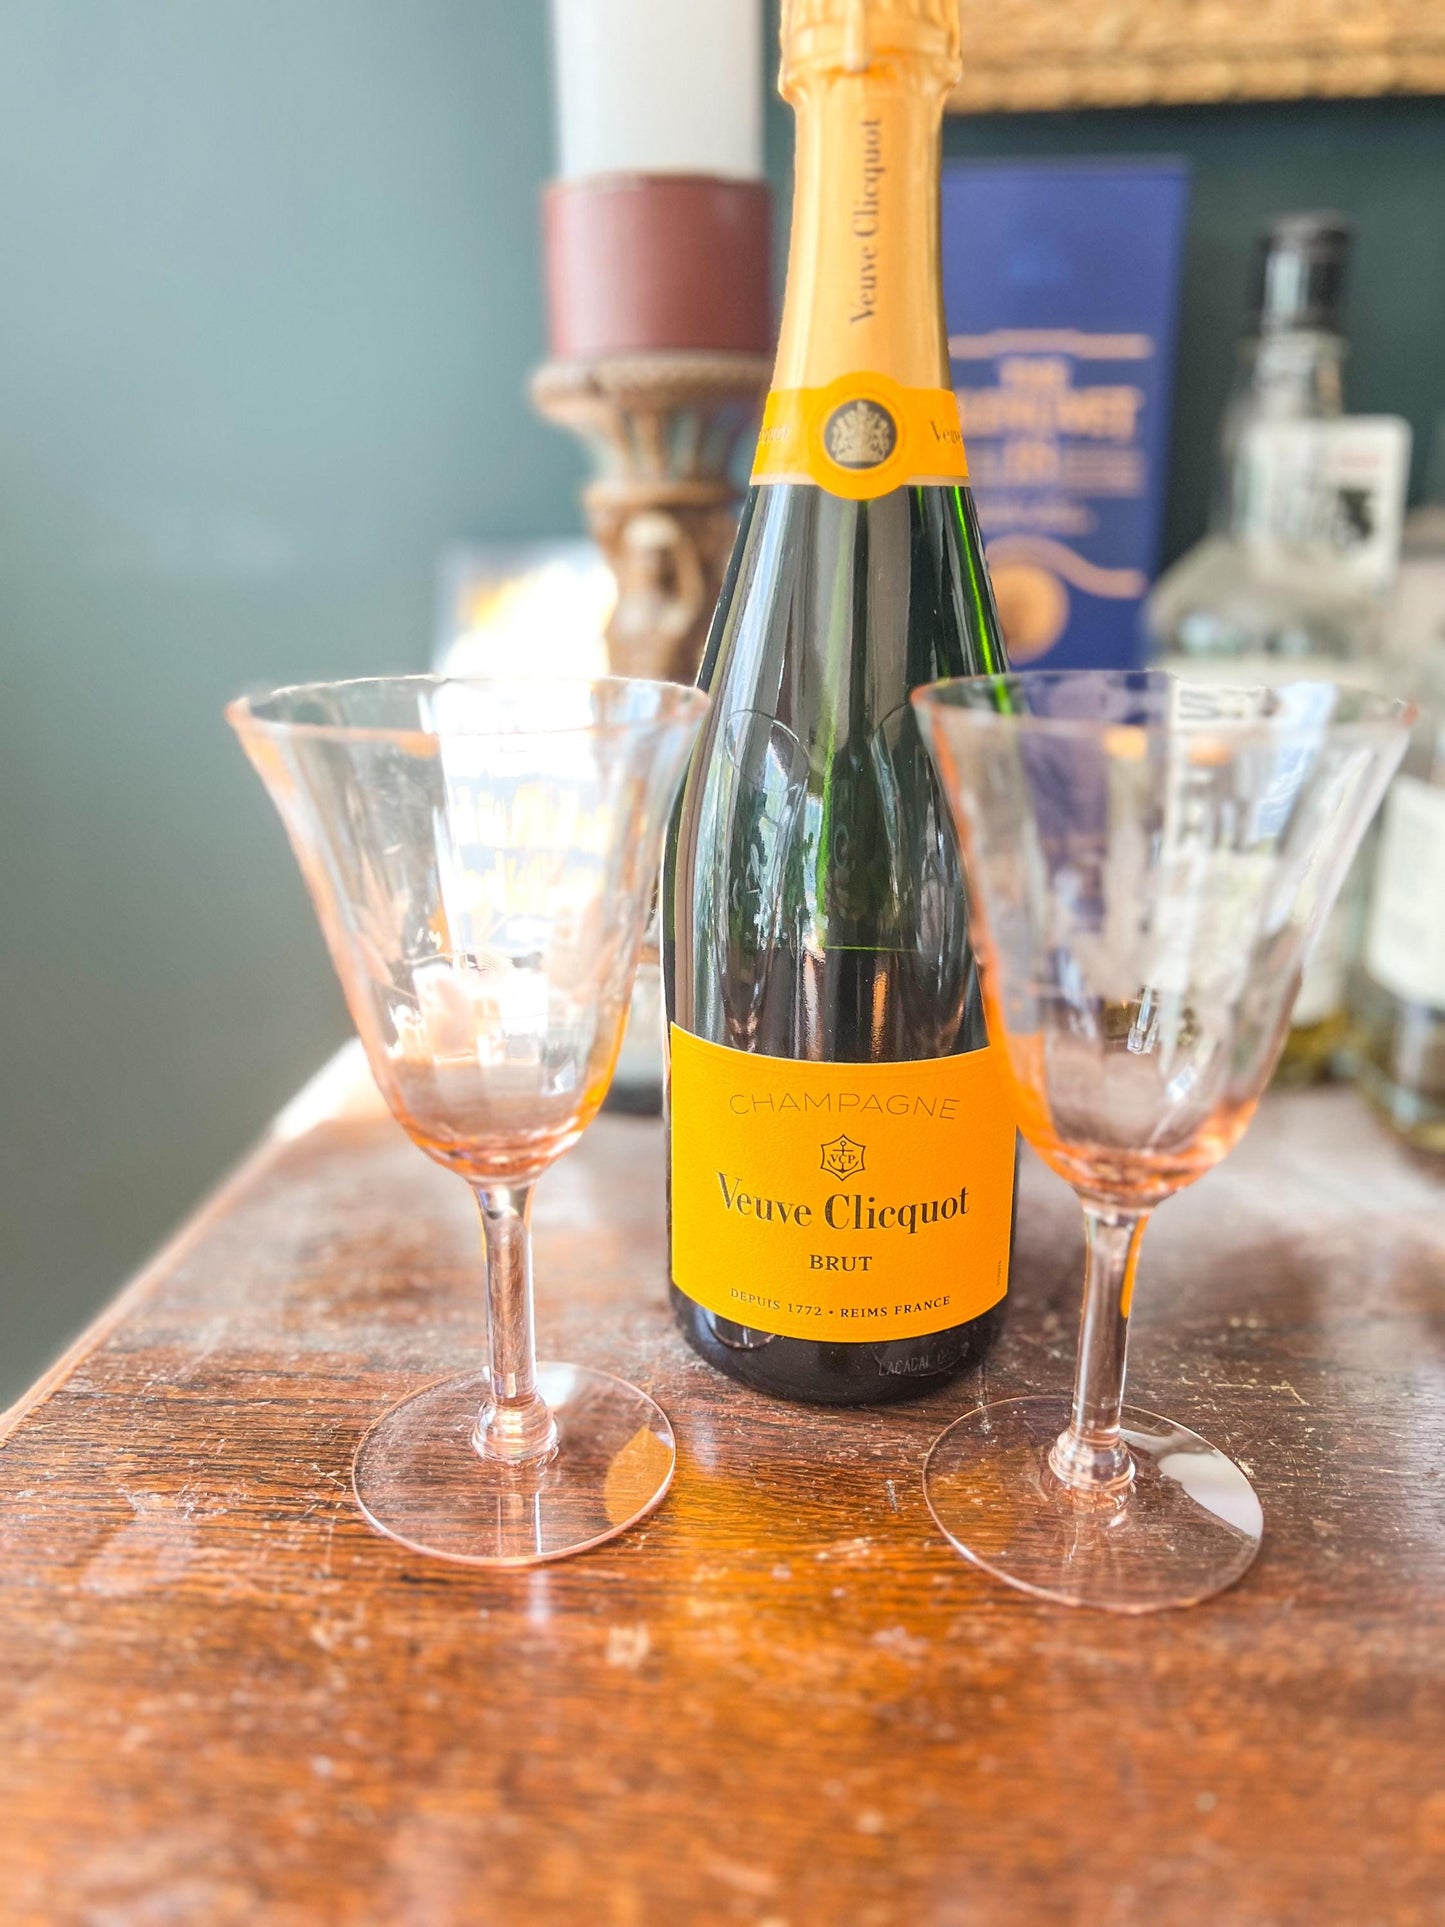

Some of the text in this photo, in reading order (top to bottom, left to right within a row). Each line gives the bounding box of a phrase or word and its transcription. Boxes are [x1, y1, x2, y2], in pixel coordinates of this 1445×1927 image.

[849, 119, 886, 324] Veuve Clicquot
[729, 1092, 960, 1120] CHAMPAGNE
[715, 1170, 970, 1235] Veuve Clicquot
[809, 1254, 873, 1271] BRUT
[730, 1287, 951, 1318] DEPUIS 1772 REIMS FRANCE
